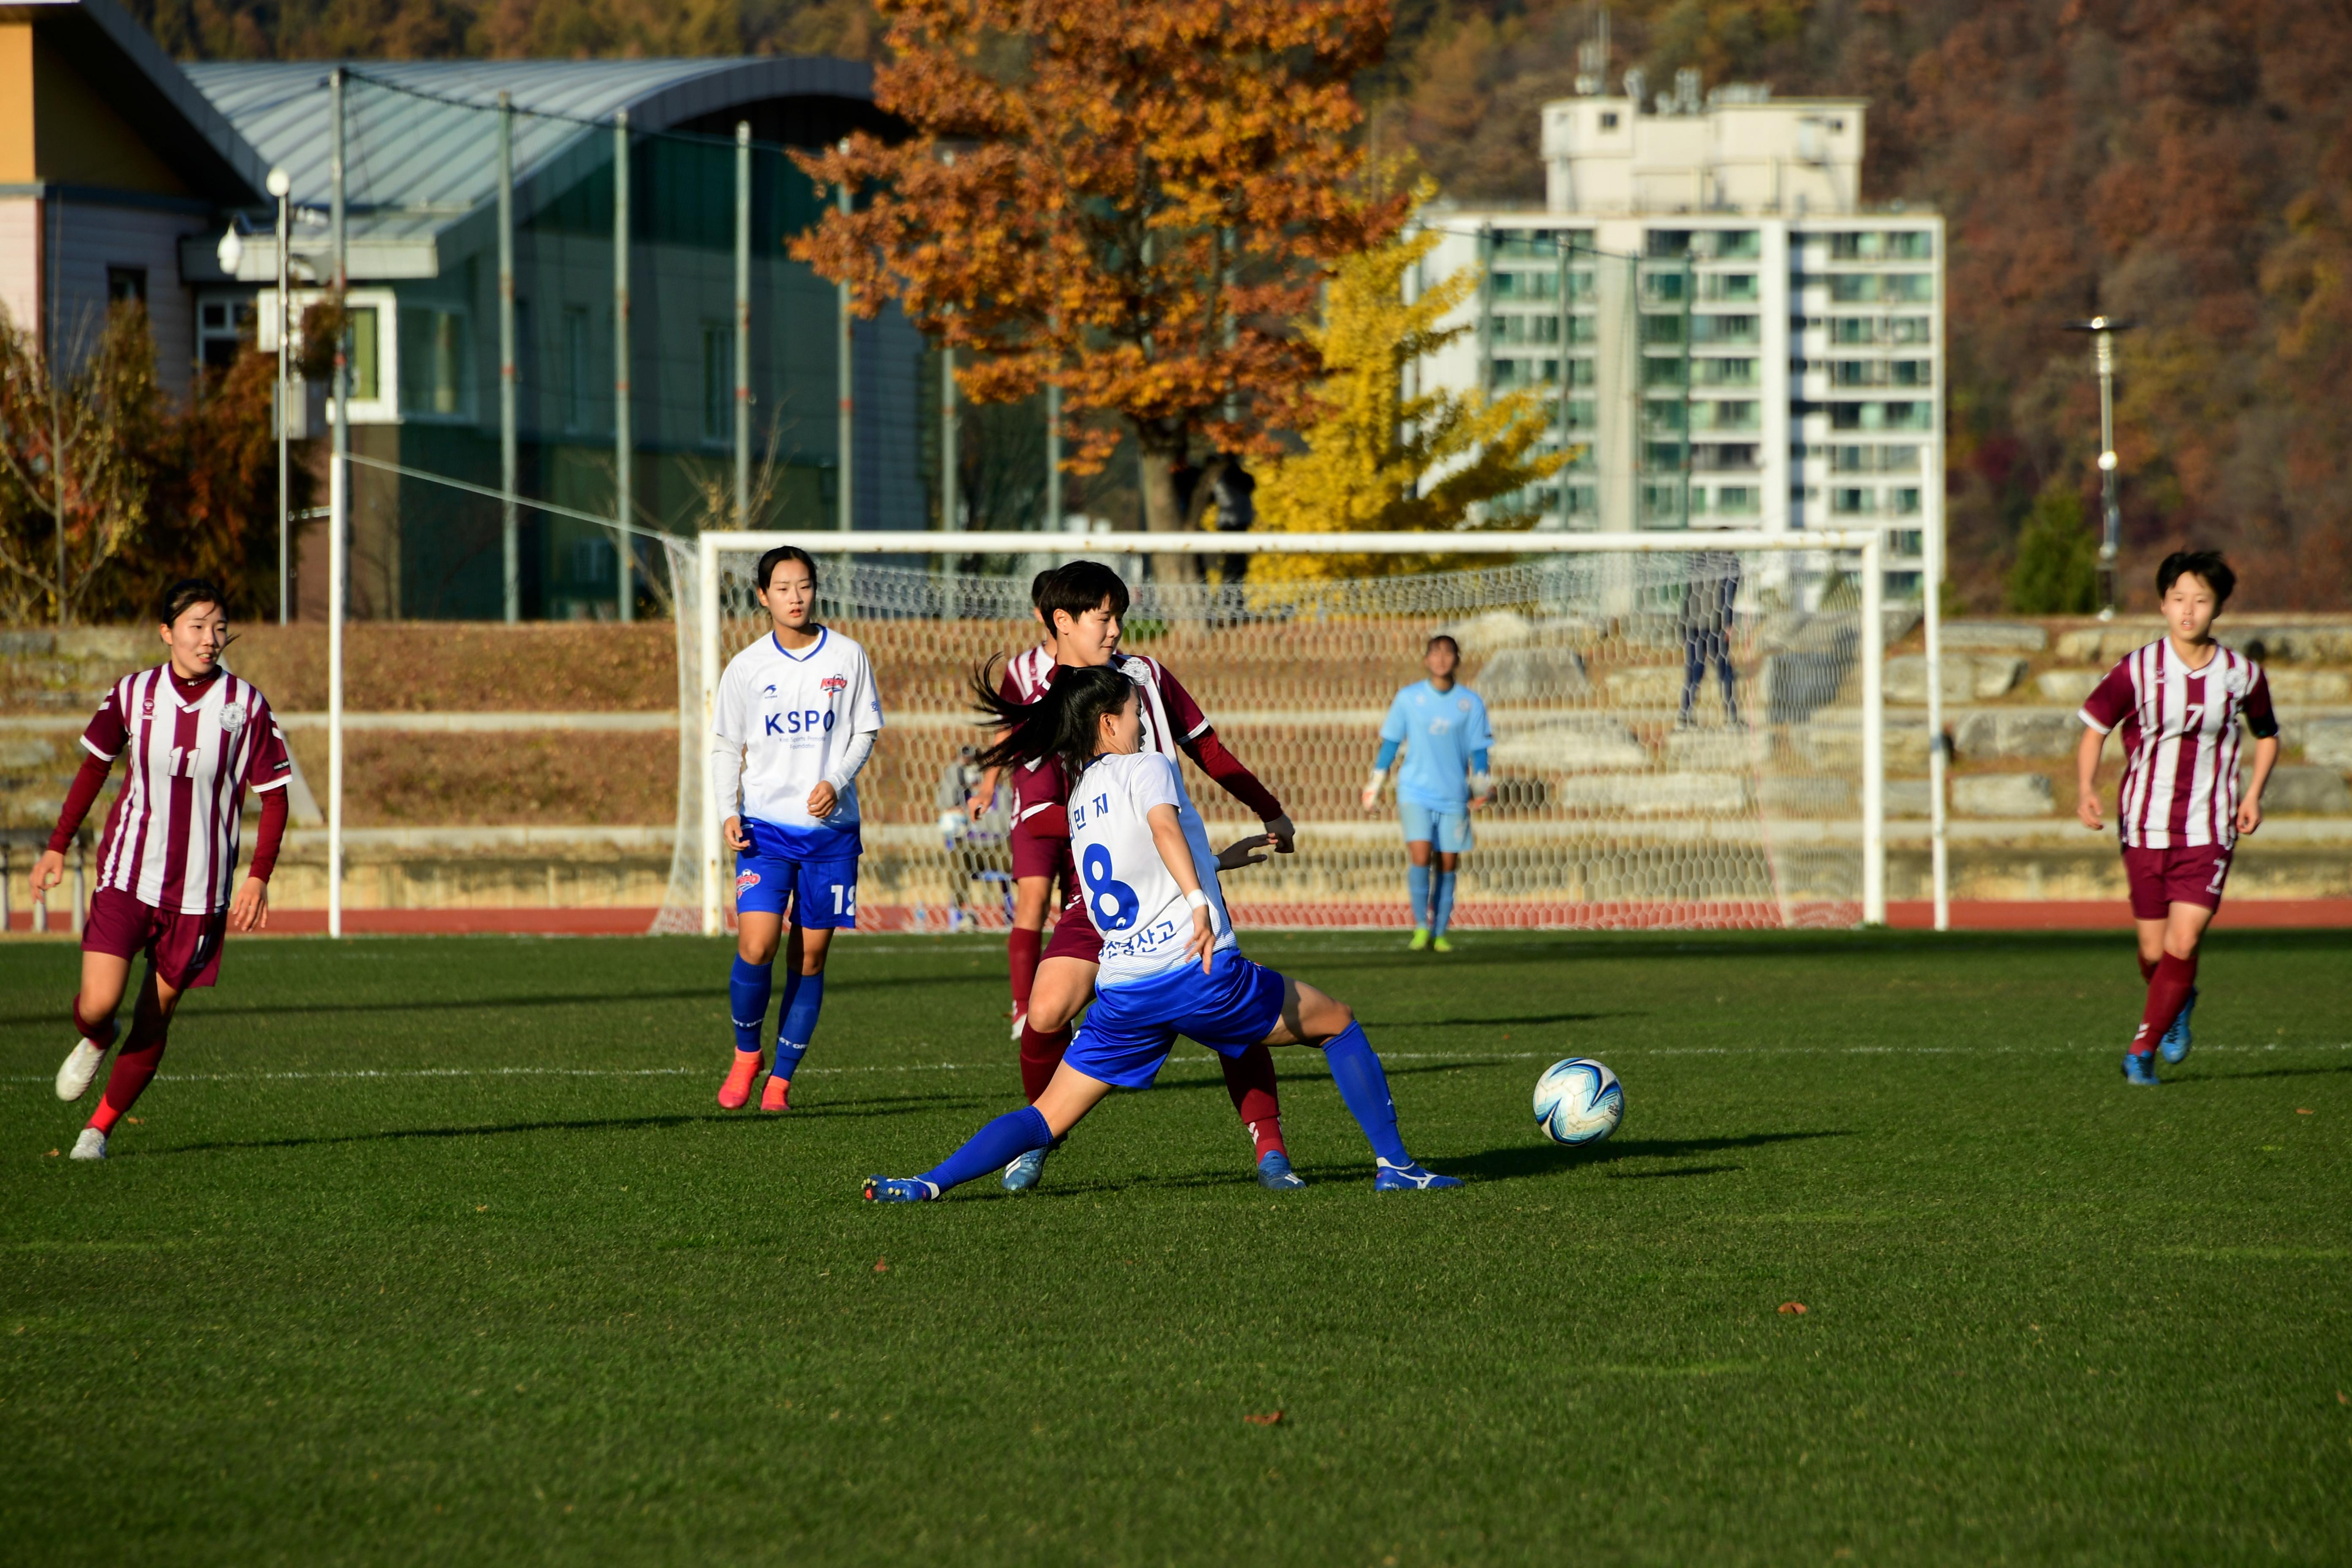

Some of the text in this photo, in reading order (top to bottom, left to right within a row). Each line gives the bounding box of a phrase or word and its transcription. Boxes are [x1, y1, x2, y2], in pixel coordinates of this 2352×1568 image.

[765, 710, 835, 736] KSPO
[2183, 704, 2204, 732] 7
[167, 746, 200, 778] 11
[1082, 843, 1139, 931] 8
